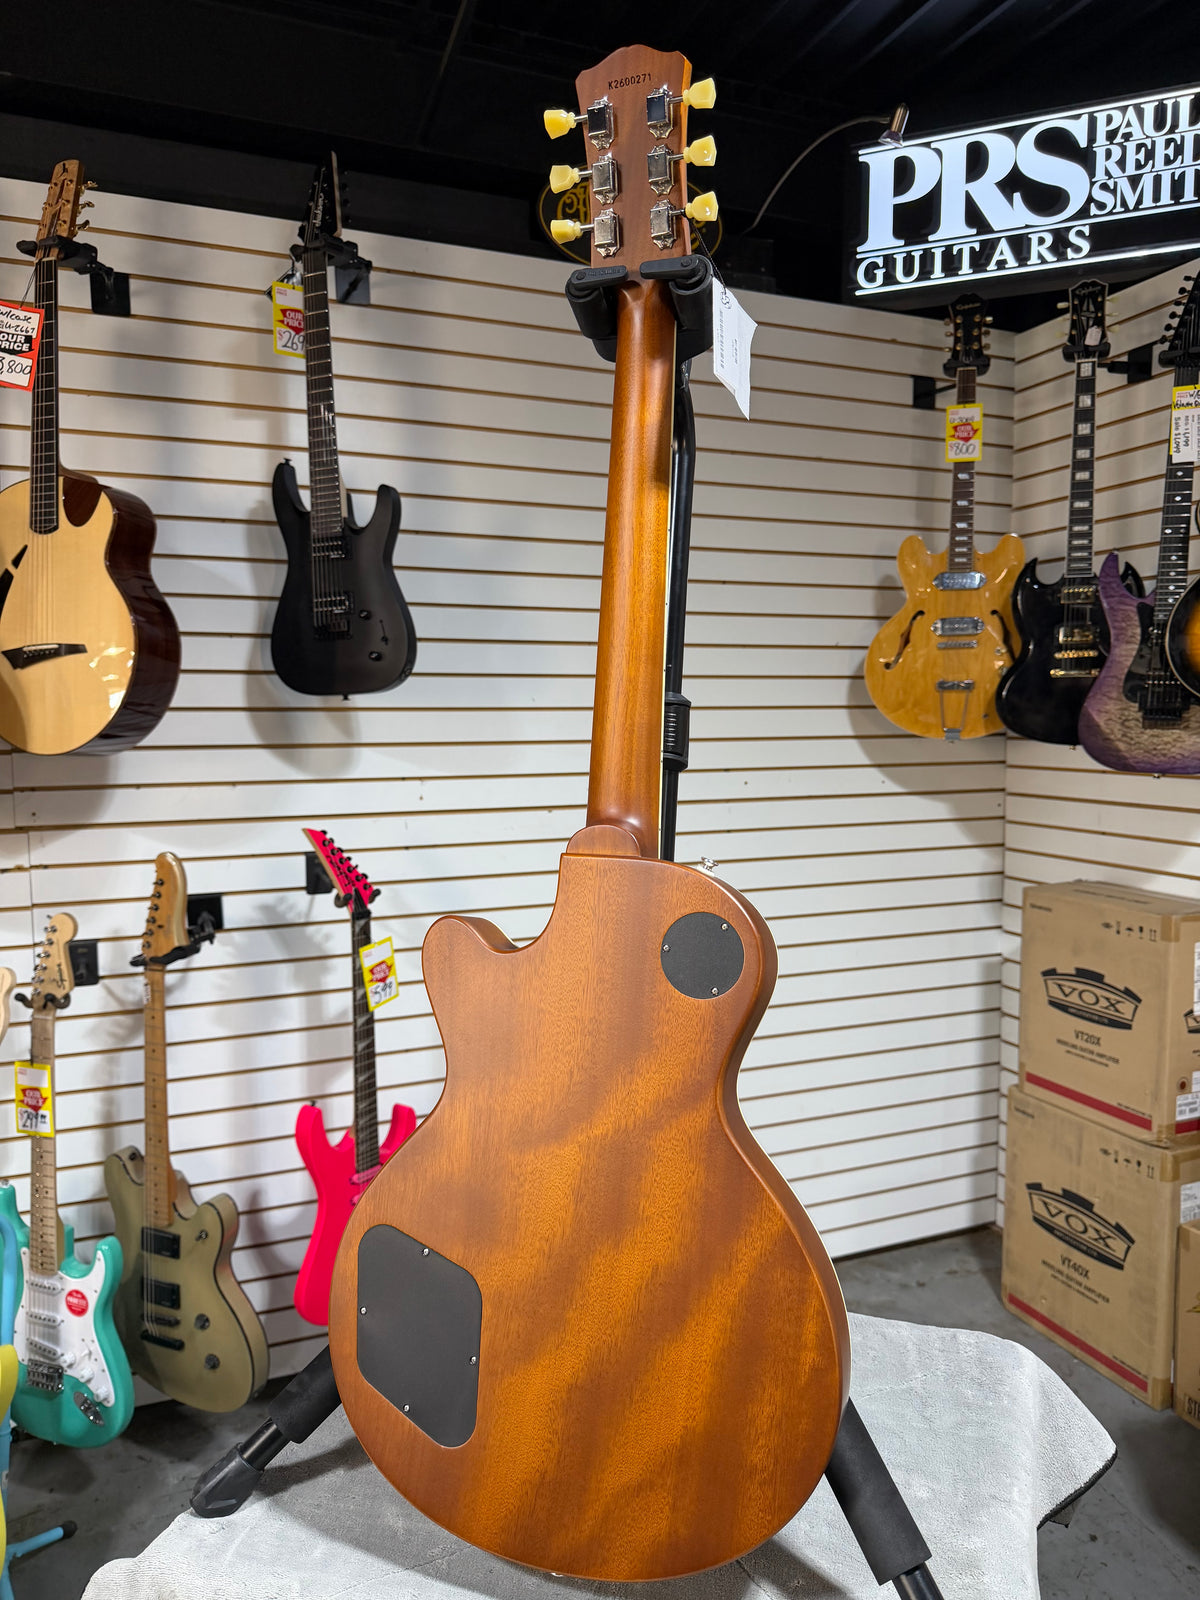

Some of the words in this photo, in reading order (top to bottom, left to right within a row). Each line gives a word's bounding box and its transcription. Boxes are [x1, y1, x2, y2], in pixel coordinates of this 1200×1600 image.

[608, 73, 652, 90] K2600271
[1093, 95, 1200, 147] PAUL
[858, 114, 1091, 252] PRS
[856, 225, 1091, 289] GUITARS
[0, 333, 25, 343] OUR
[0, 341, 30, 352] RICE
[1054, 983, 1127, 1015] VOX
[1039, 1199, 1118, 1253] VOX
